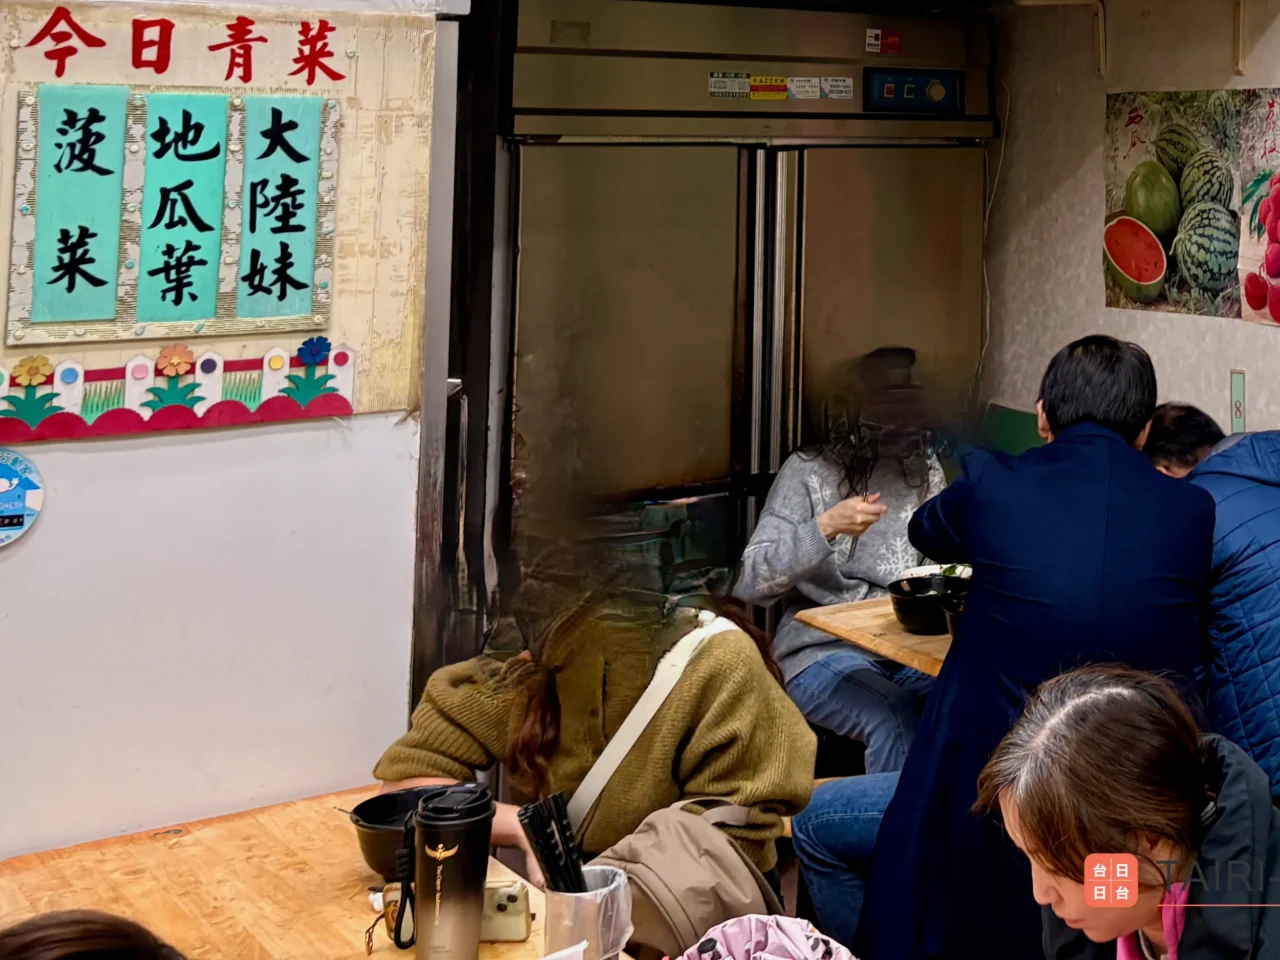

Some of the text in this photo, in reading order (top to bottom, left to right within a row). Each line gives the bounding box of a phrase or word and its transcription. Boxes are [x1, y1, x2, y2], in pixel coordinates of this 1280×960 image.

[25, 6, 346, 86] 今日青菜
[147, 109, 220, 306] 地瓜葉
[241, 107, 310, 302] 大陸妹
[1235, 400, 1242, 419] 8
